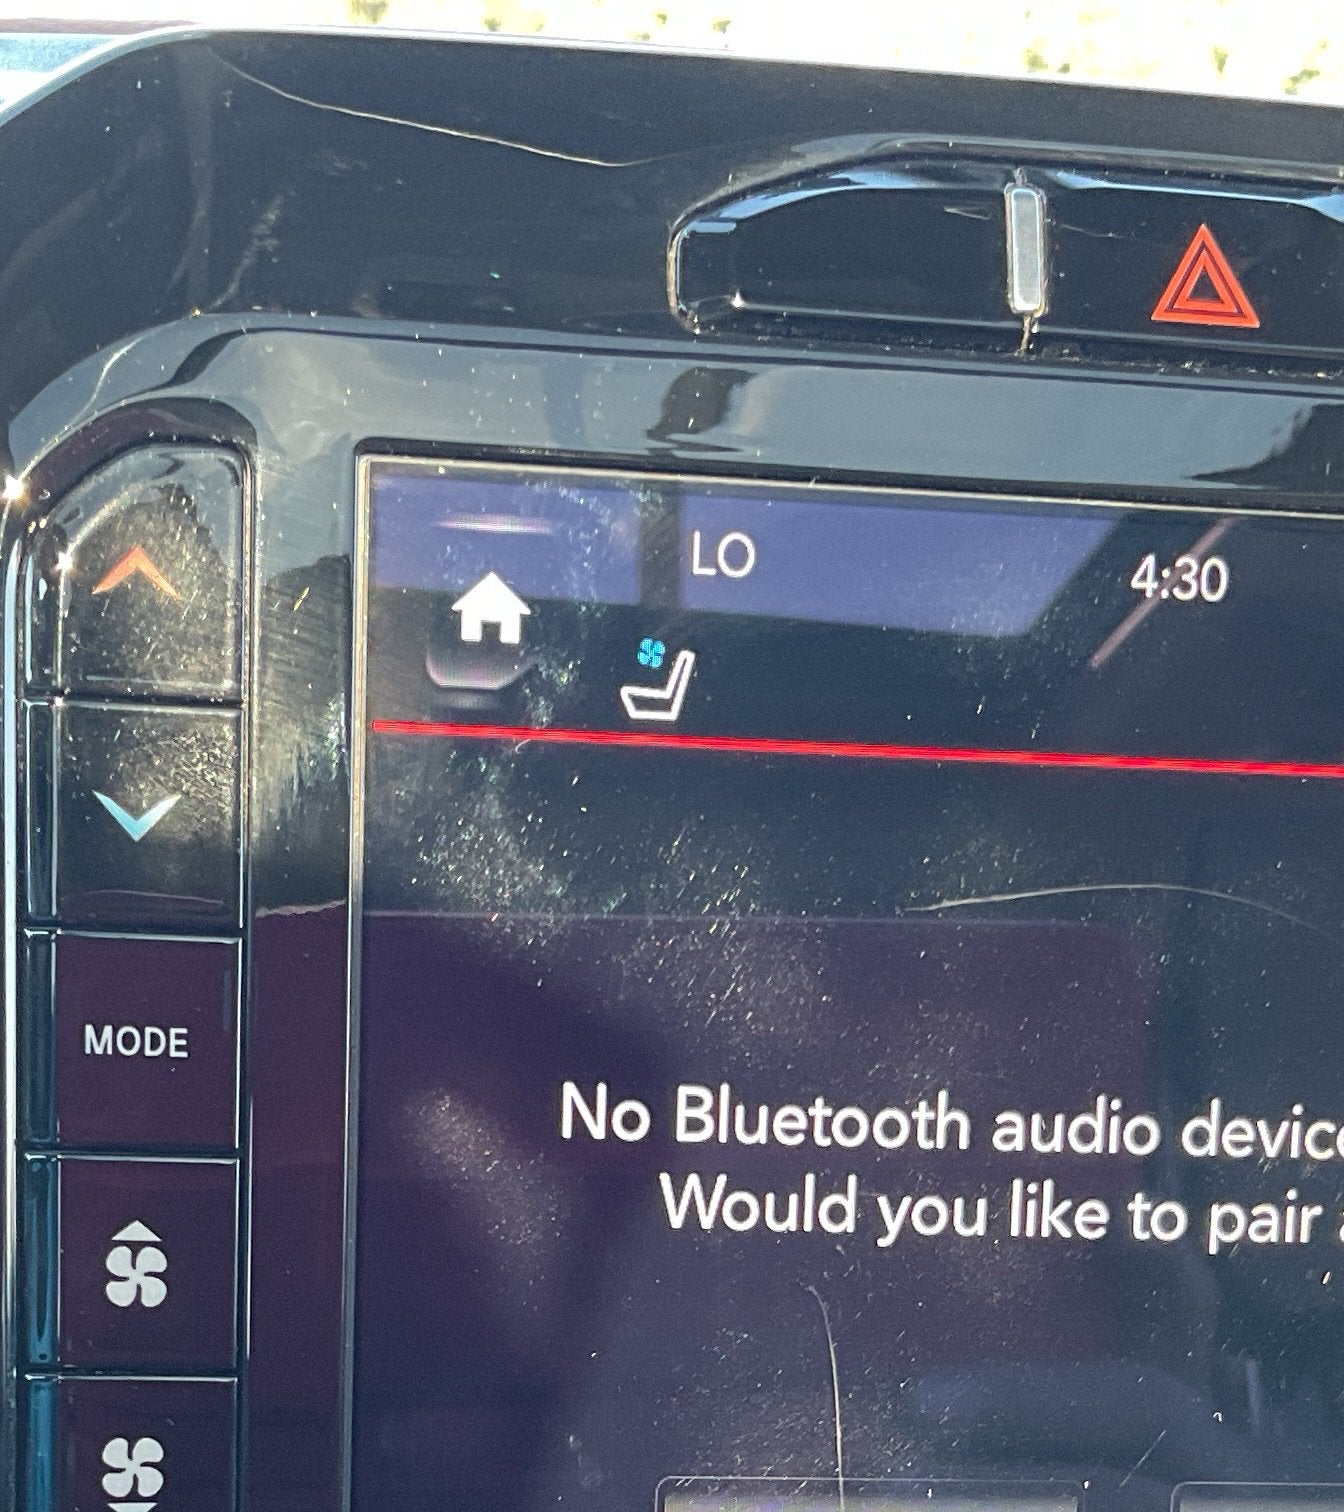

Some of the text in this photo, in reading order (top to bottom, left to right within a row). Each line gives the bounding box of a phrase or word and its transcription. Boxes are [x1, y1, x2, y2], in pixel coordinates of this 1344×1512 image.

[693, 531, 755, 578] LO
[1130, 556, 1228, 605] 4:30
[85, 1024, 188, 1057] MODE
[562, 1082, 650, 1141] No
[676, 1083, 970, 1149] Bluetooth
[992, 1094, 1160, 1155] audio
[659, 1173, 857, 1233] Would
[877, 1195, 987, 1247] you
[1011, 1178, 1109, 1239] like
[1127, 1193, 1187, 1241] to
[1209, 1195, 1323, 1254] pair
